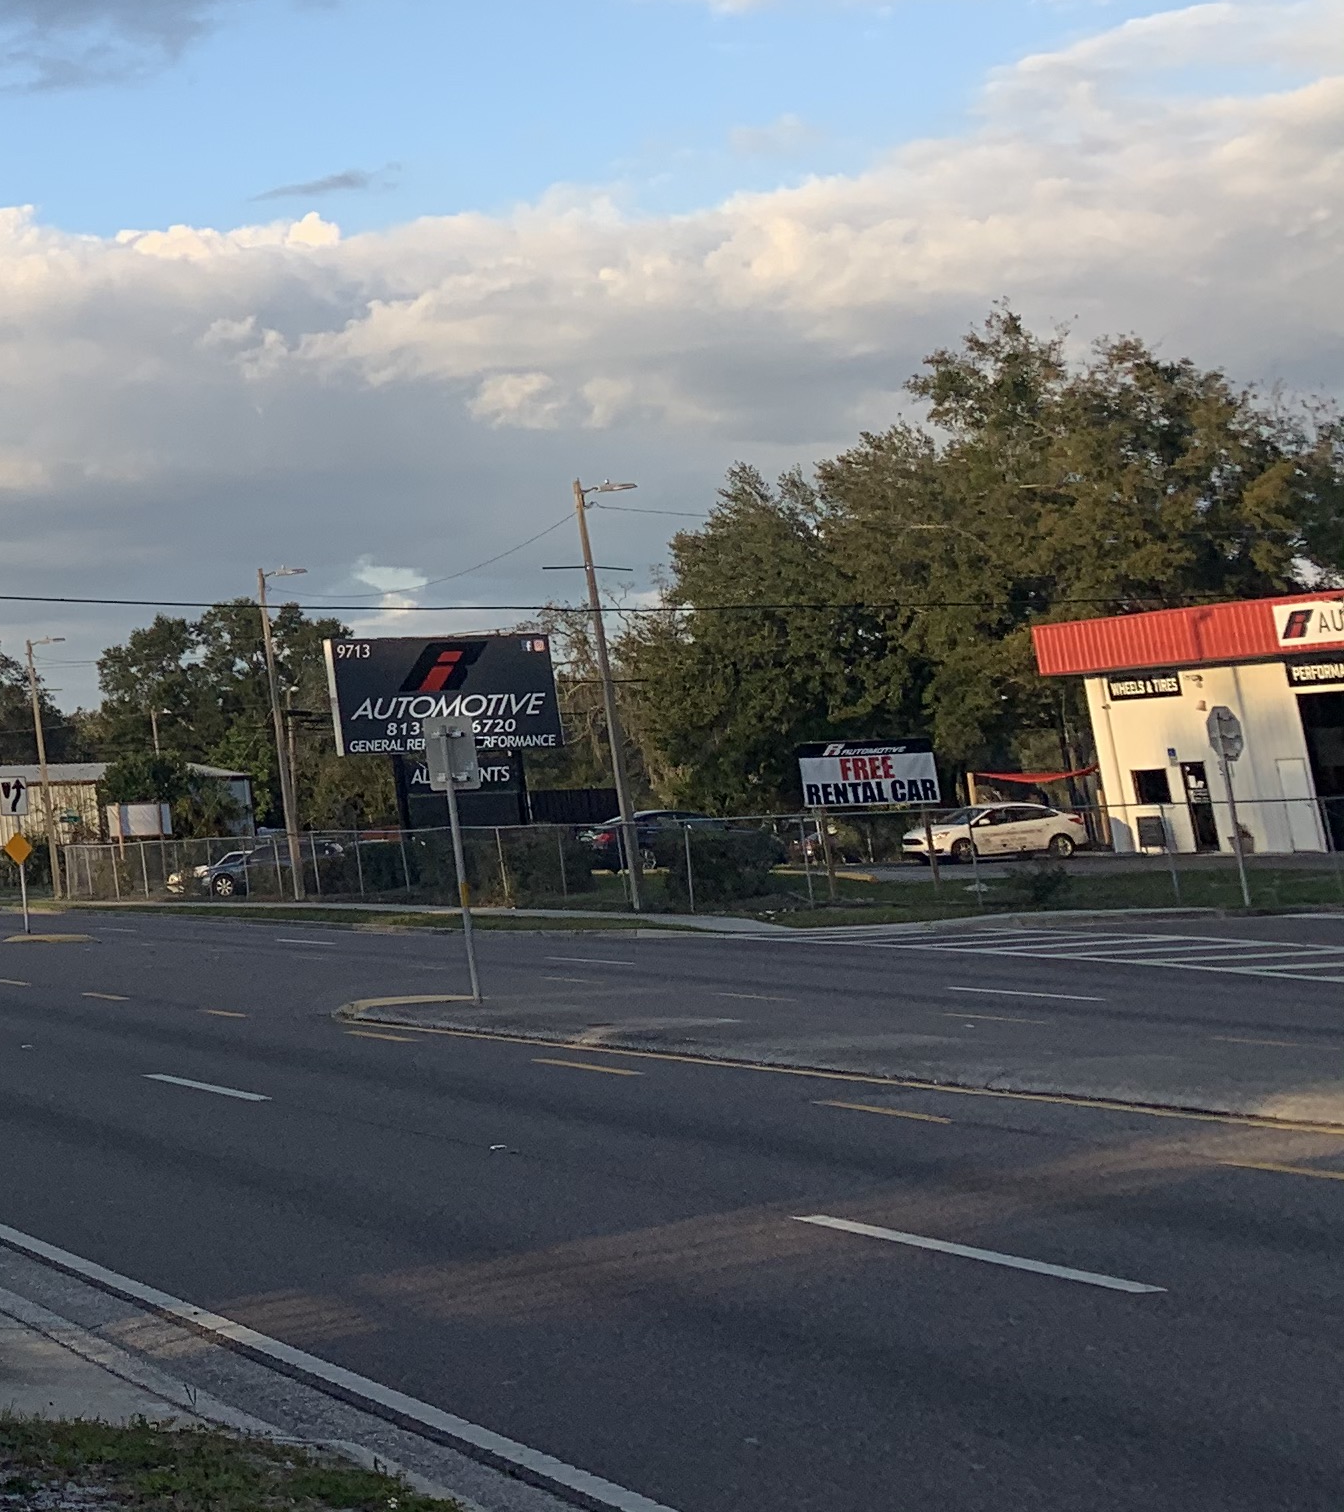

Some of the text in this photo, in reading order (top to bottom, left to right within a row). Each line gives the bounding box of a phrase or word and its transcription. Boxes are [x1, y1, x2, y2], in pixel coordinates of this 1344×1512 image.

[336, 644, 370, 658] 9713
[1110, 680, 1145, 696] WHEELS
[1151, 678, 1179, 692] TIRES
[351, 692, 546, 720] AUTOMOTIVE
[349, 738, 404, 752] GENERAL
[841, 746, 907, 756] AUTOMOTIVE
[839, 755, 896, 781] FREE
[805, 779, 938, 805] RENTAL CAR
